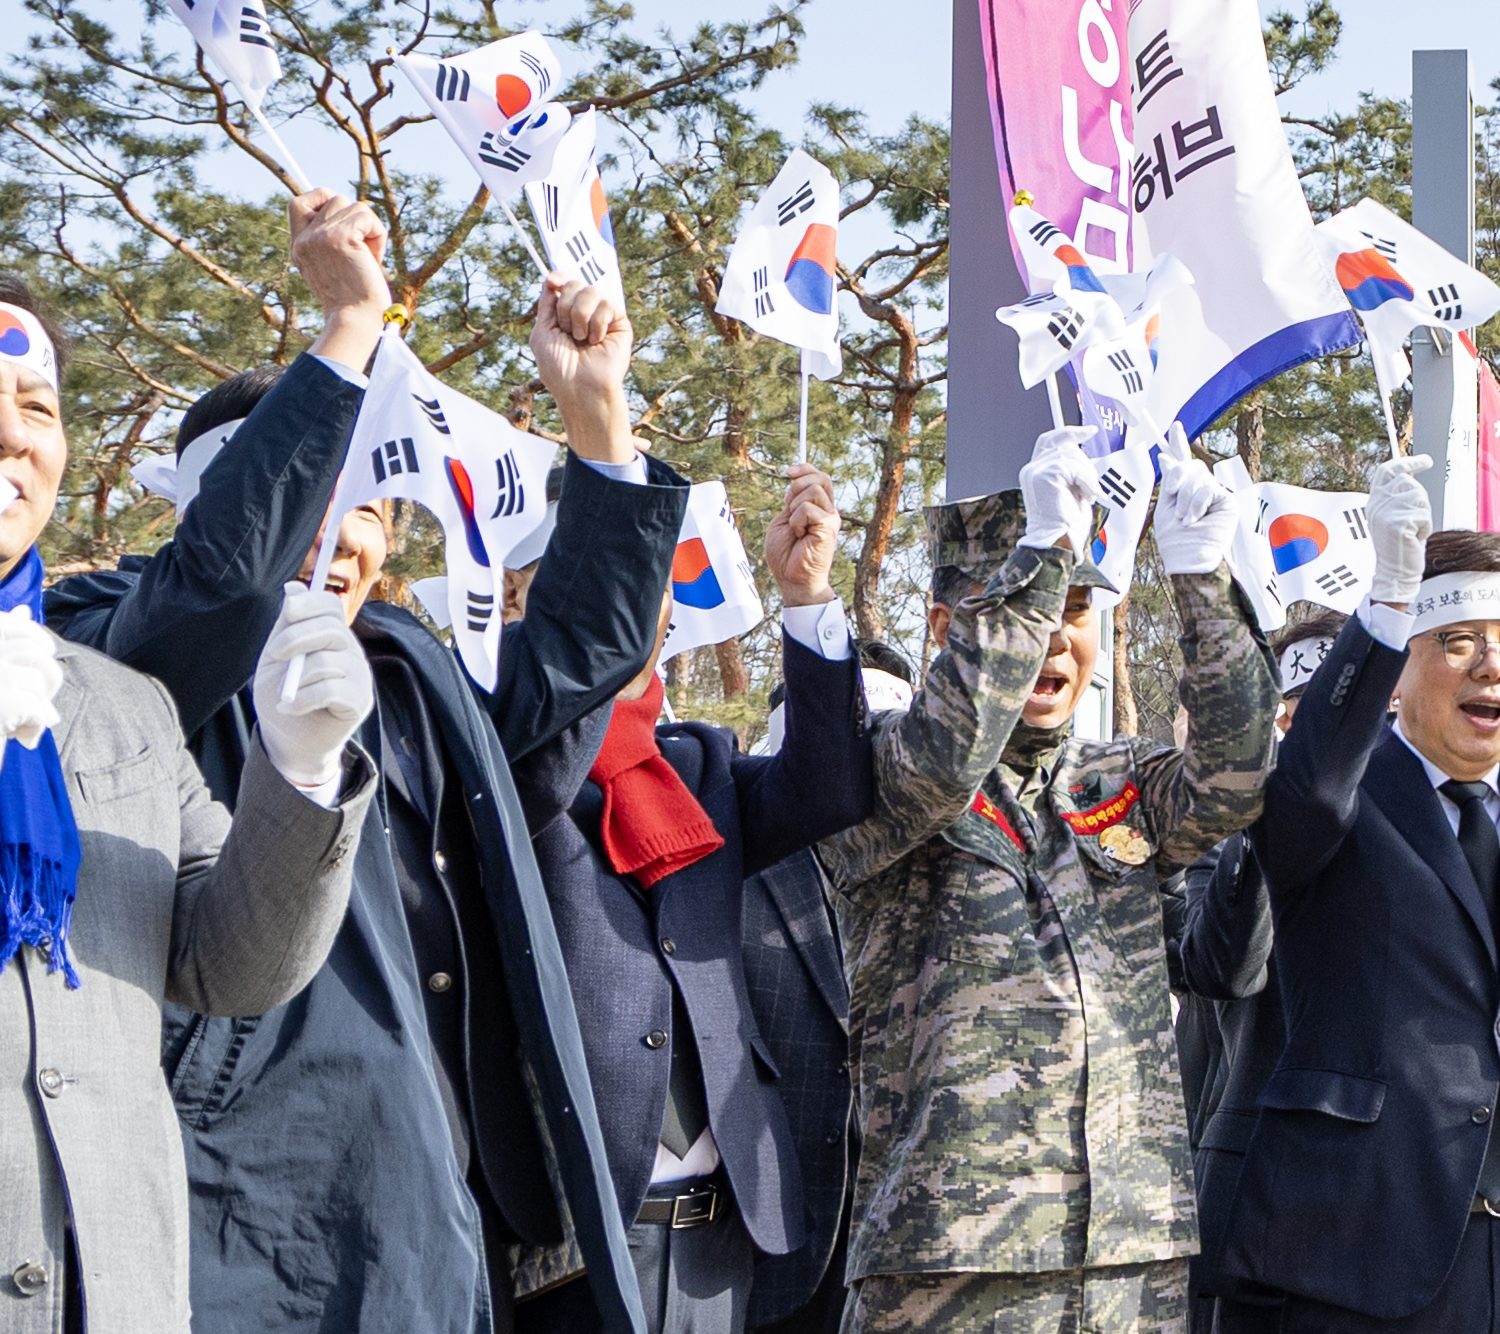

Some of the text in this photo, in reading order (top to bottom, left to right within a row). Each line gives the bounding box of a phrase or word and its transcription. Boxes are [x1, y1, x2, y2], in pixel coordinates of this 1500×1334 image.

[1132, 105, 1236, 214] 허브
[1095, 403, 1124, 436] 남시
[1439, 589, 1474, 607] 보훈의
[1478, 589, 1500, 603] 도시
